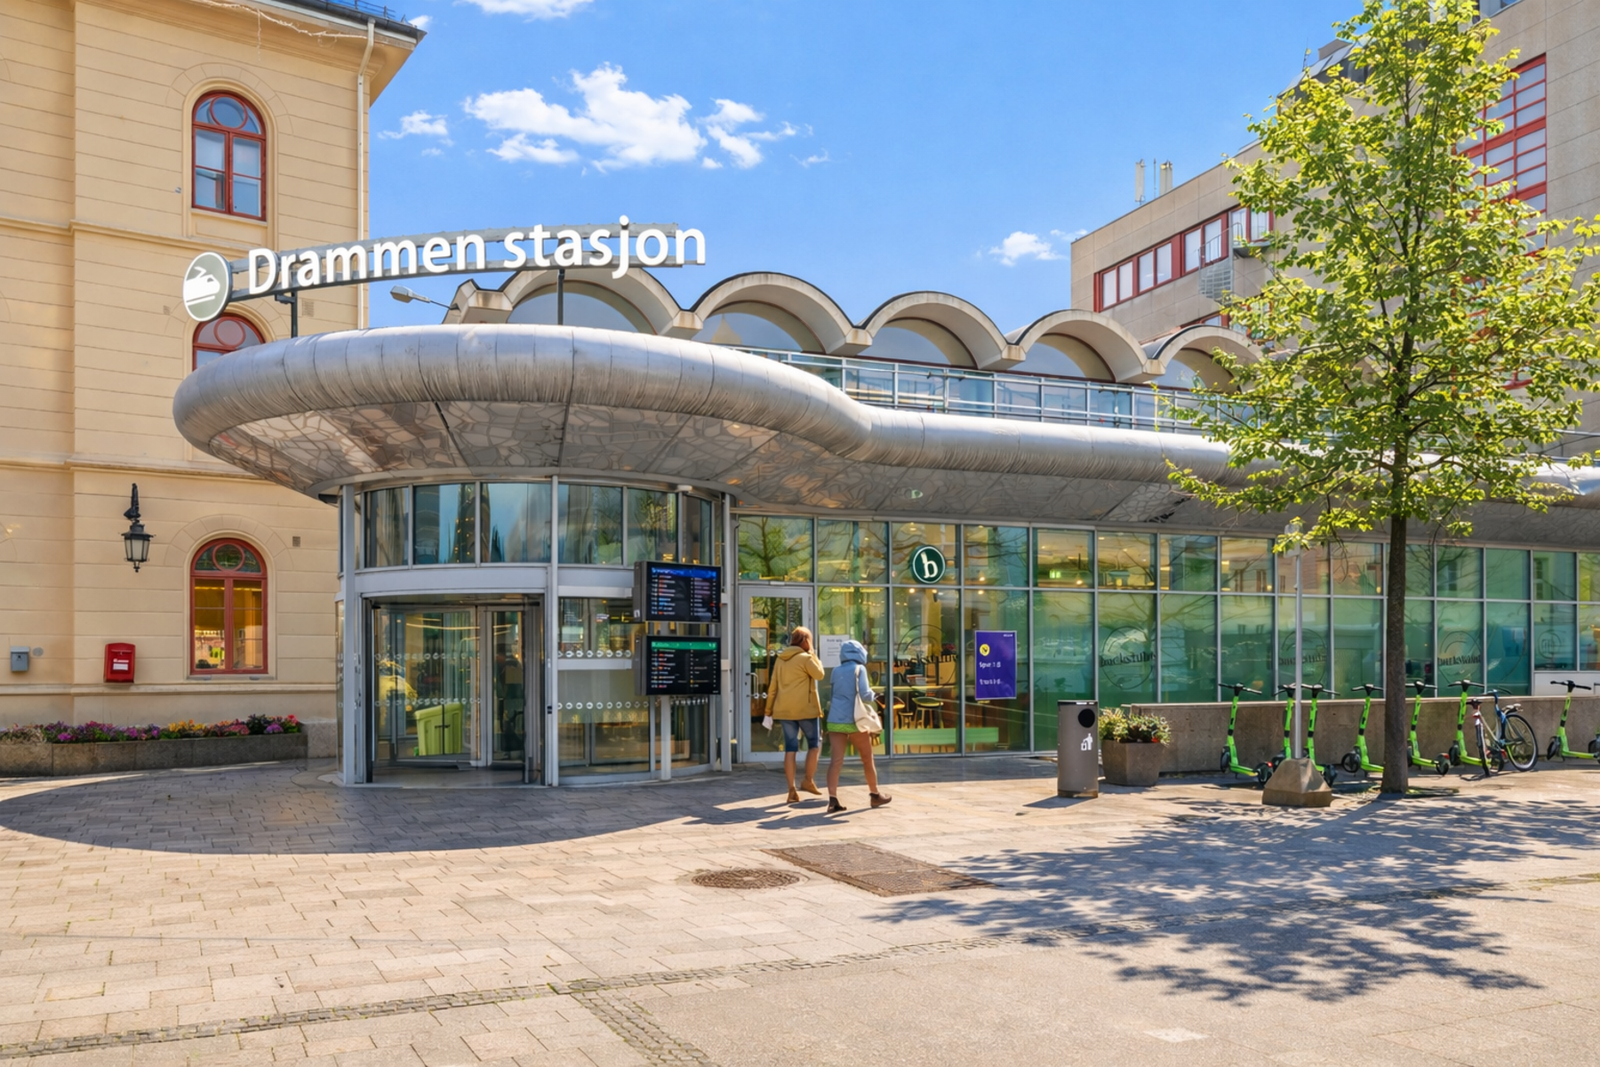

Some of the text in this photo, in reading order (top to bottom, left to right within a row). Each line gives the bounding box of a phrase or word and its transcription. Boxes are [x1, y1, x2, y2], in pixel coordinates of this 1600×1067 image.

[248, 214, 706, 295] Drammen stasjon
[920, 551, 939, 579] b
